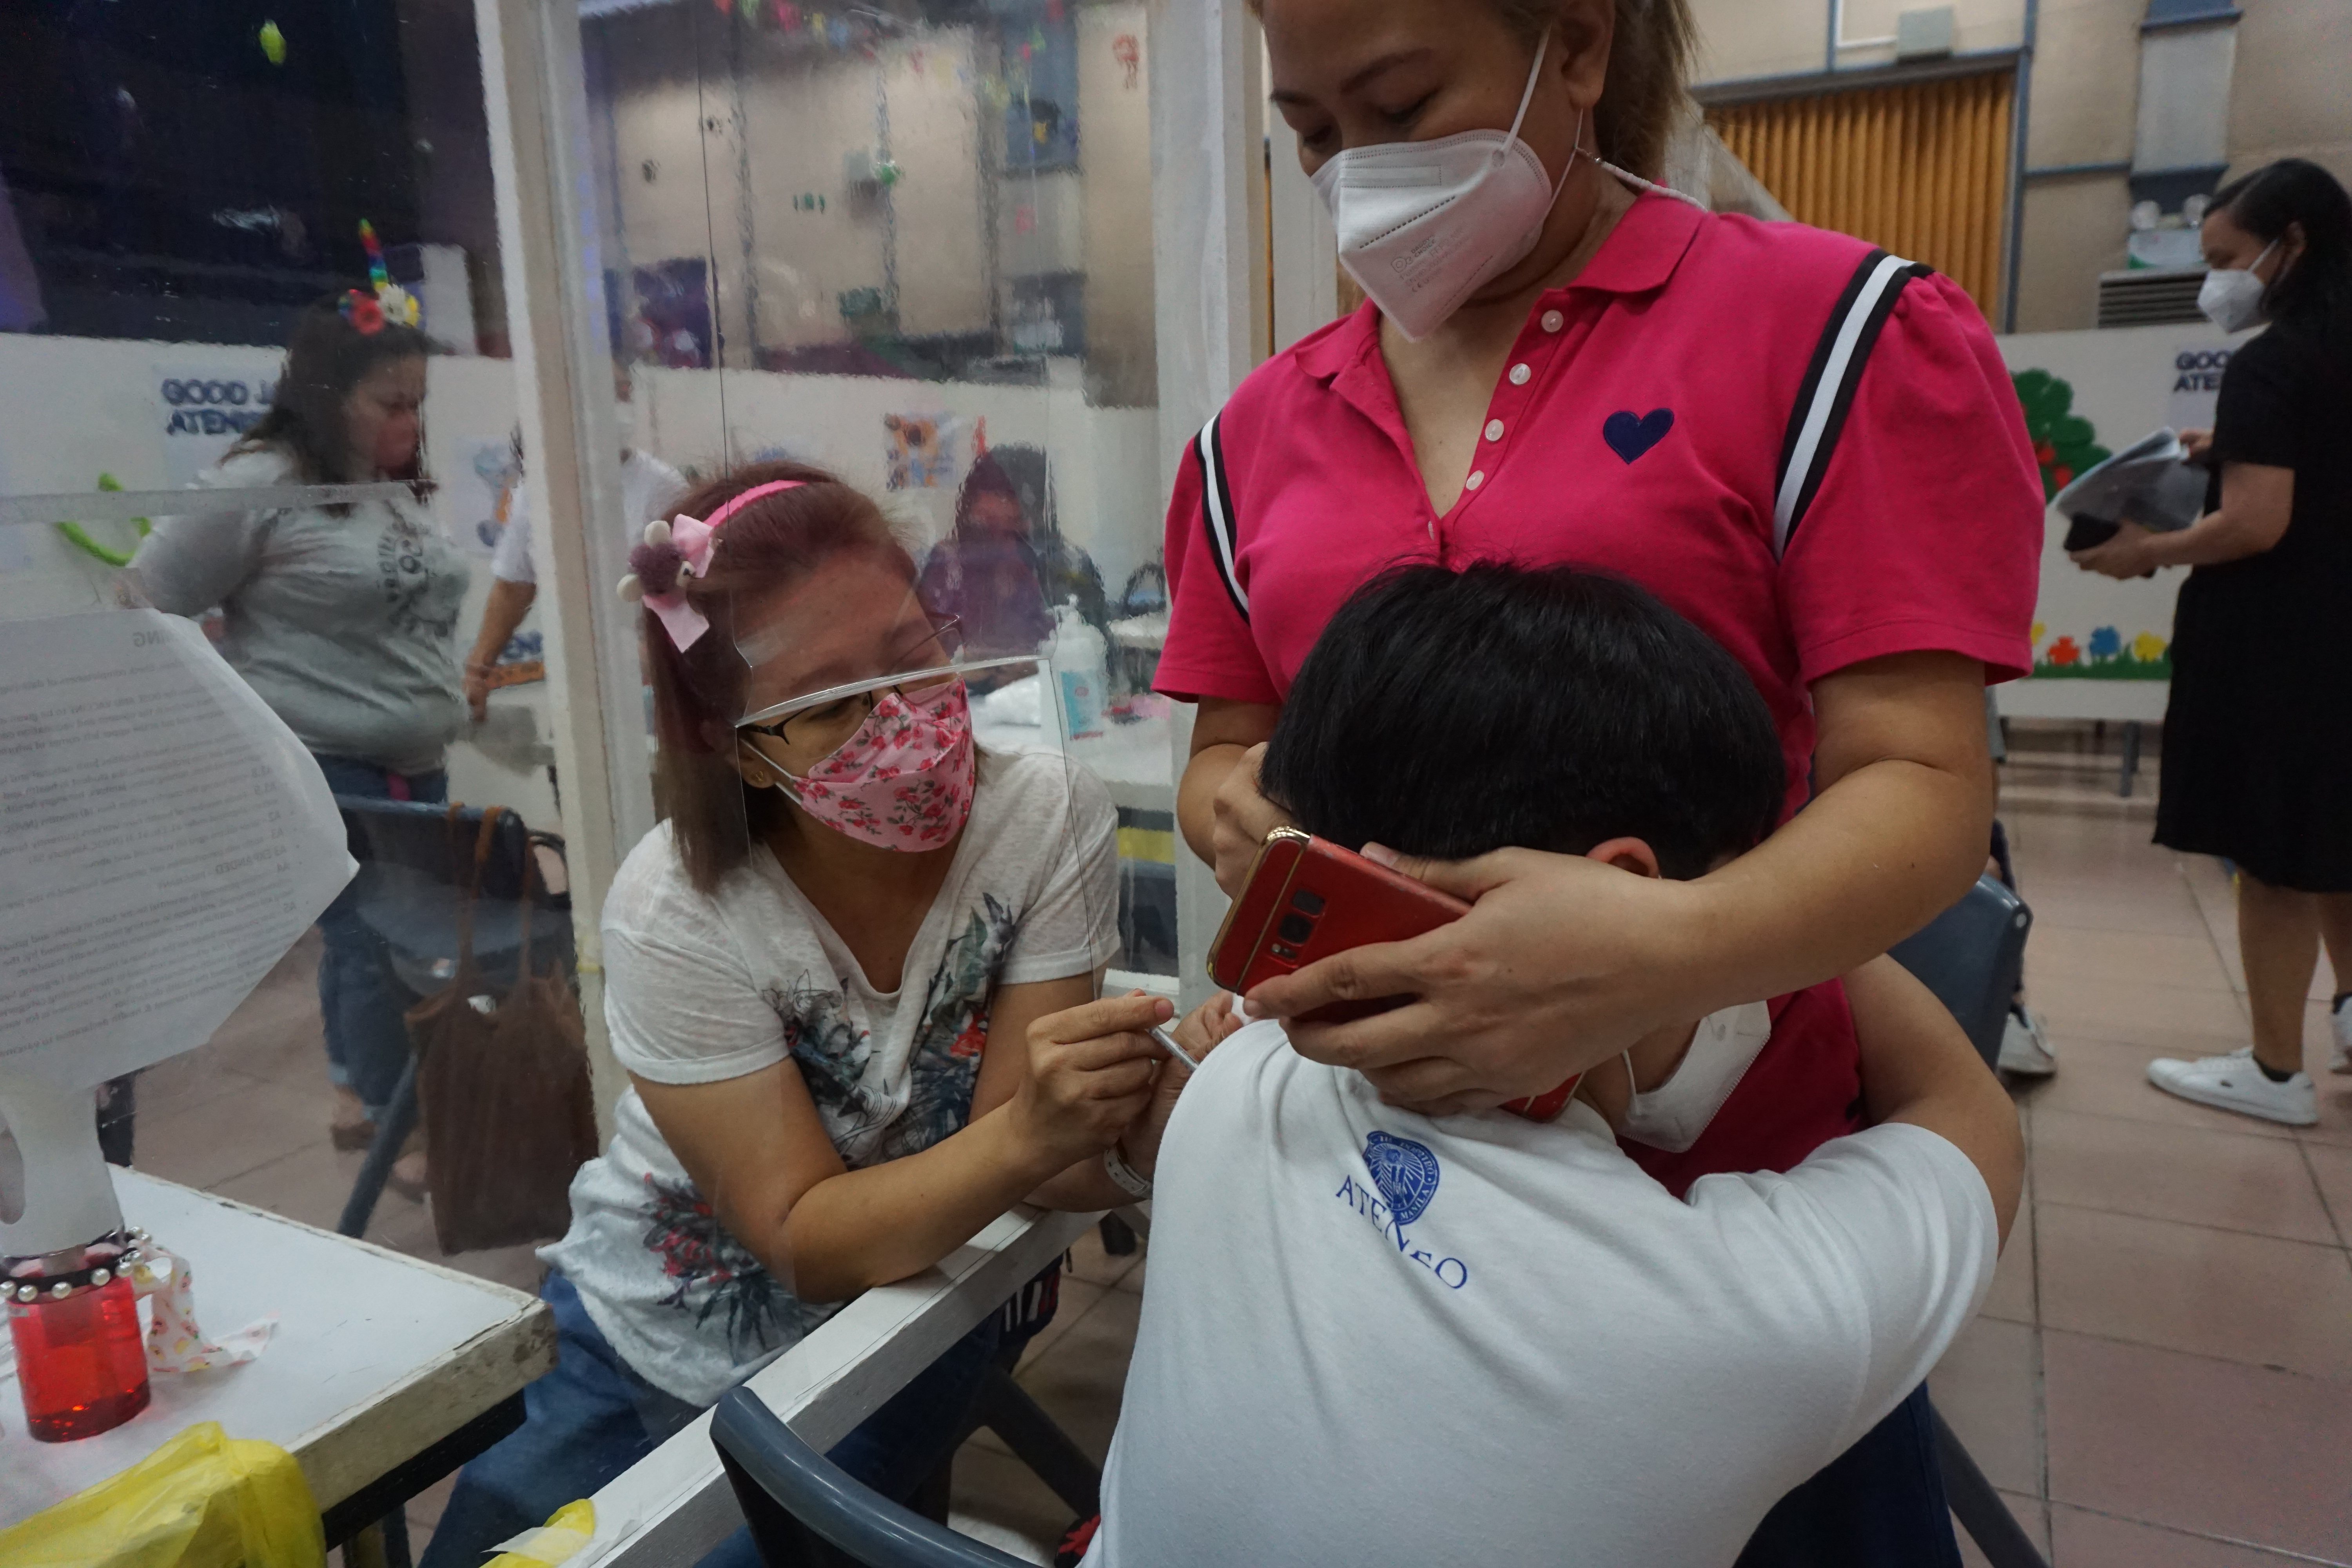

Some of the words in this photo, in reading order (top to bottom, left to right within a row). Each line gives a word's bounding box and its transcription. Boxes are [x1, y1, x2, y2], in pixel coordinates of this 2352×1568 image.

[2176, 350, 2233, 369] GOO
[161, 378, 249, 406] GOOD
[2174, 373, 2221, 391] ATE
[165, 408, 263, 435] ATEN
[1400, 1189, 1430, 1220] MANILA
